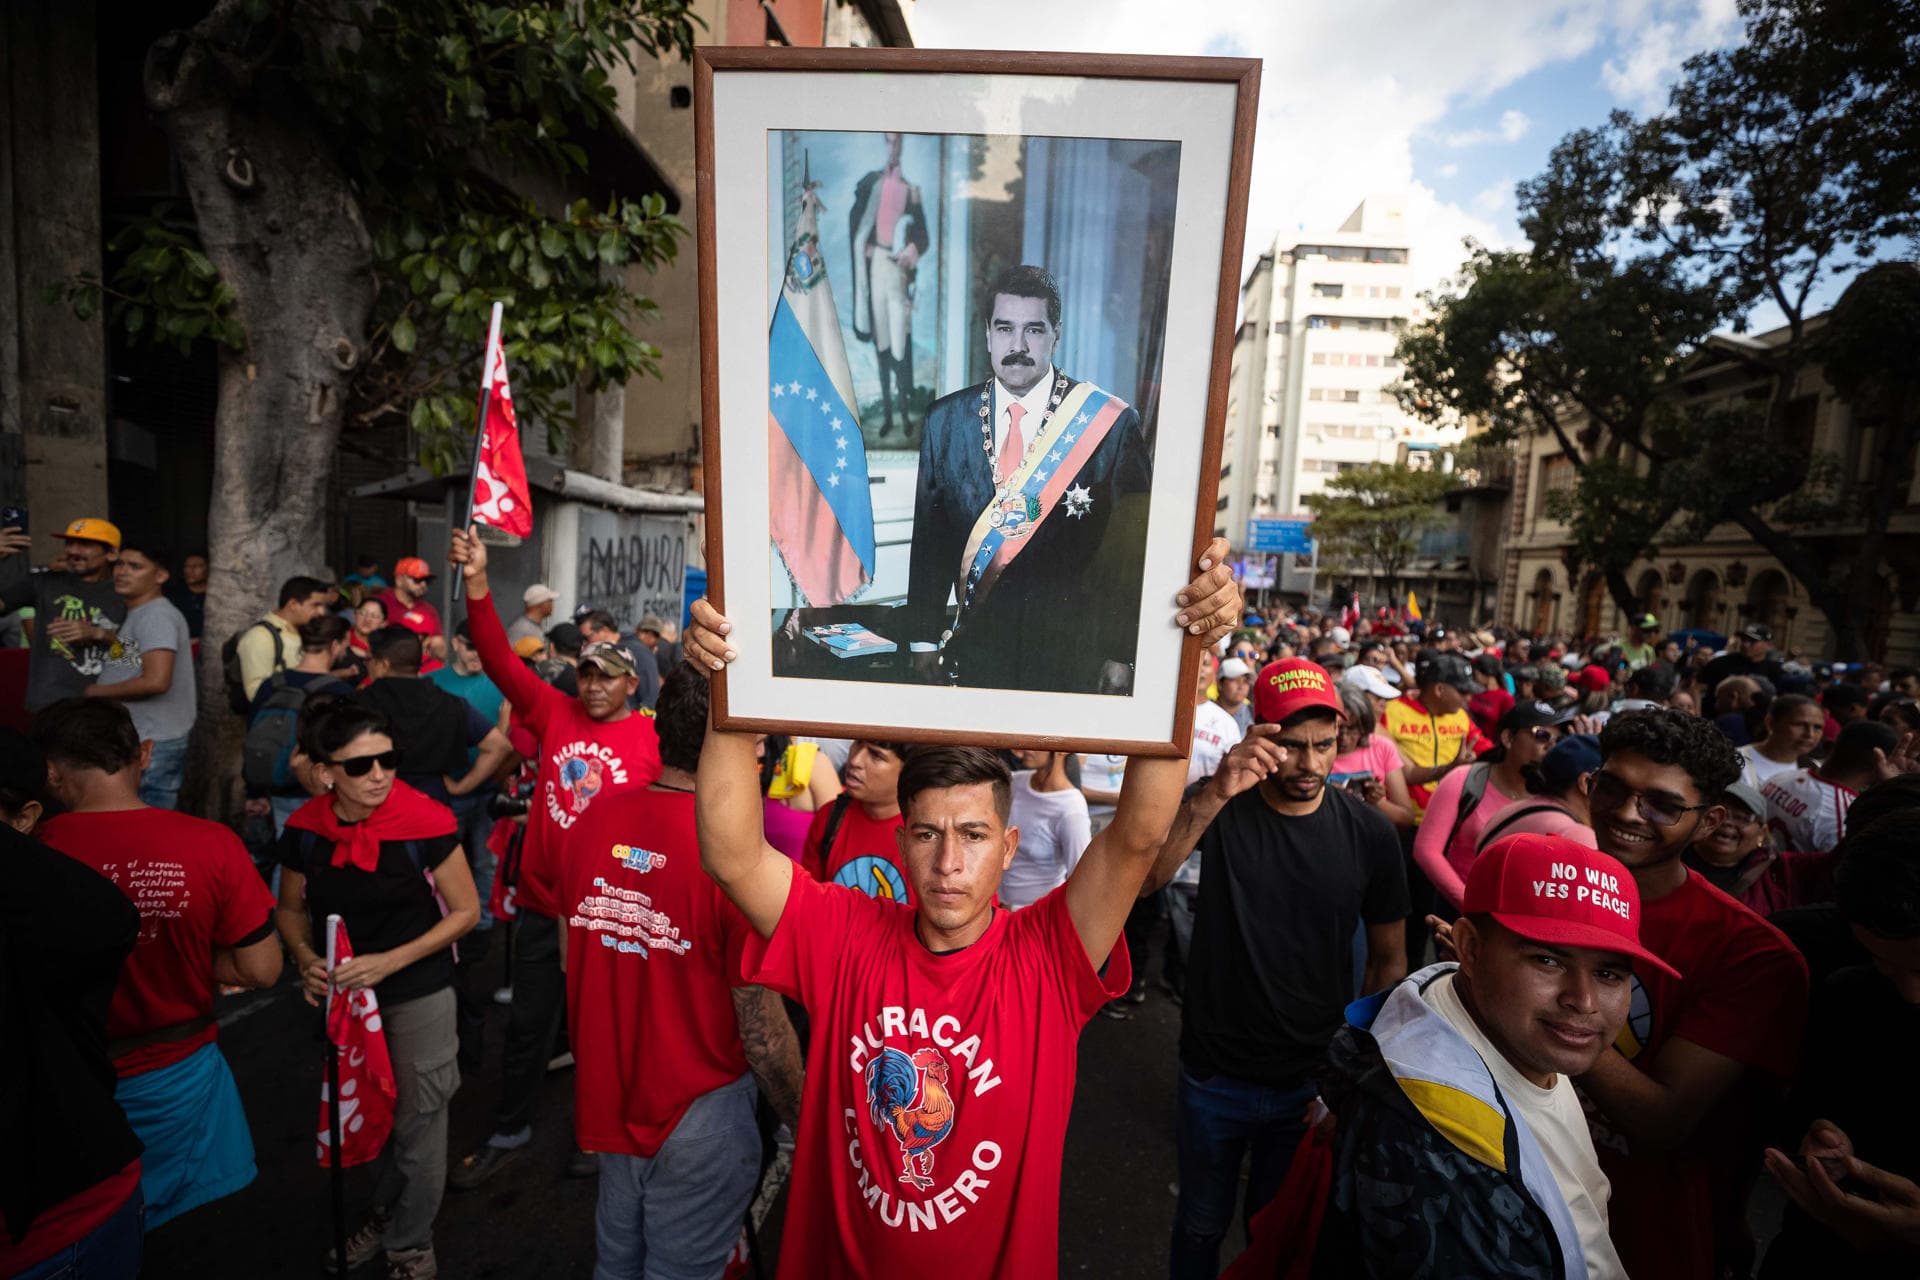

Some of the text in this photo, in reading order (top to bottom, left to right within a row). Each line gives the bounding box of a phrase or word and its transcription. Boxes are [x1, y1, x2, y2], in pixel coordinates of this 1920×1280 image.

[588, 534, 684, 600] MADURO
[1279, 679, 1325, 693] MAIZAL
[552, 741, 629, 785] HURACAN
[612, 844, 667, 869] comuna
[1551, 862, 1619, 894] NO WAR
[1533, 881, 1630, 920] YES PEACE!
[850, 1006, 1002, 1097] HURACAN
[845, 1108, 1002, 1232] COMUNERO
